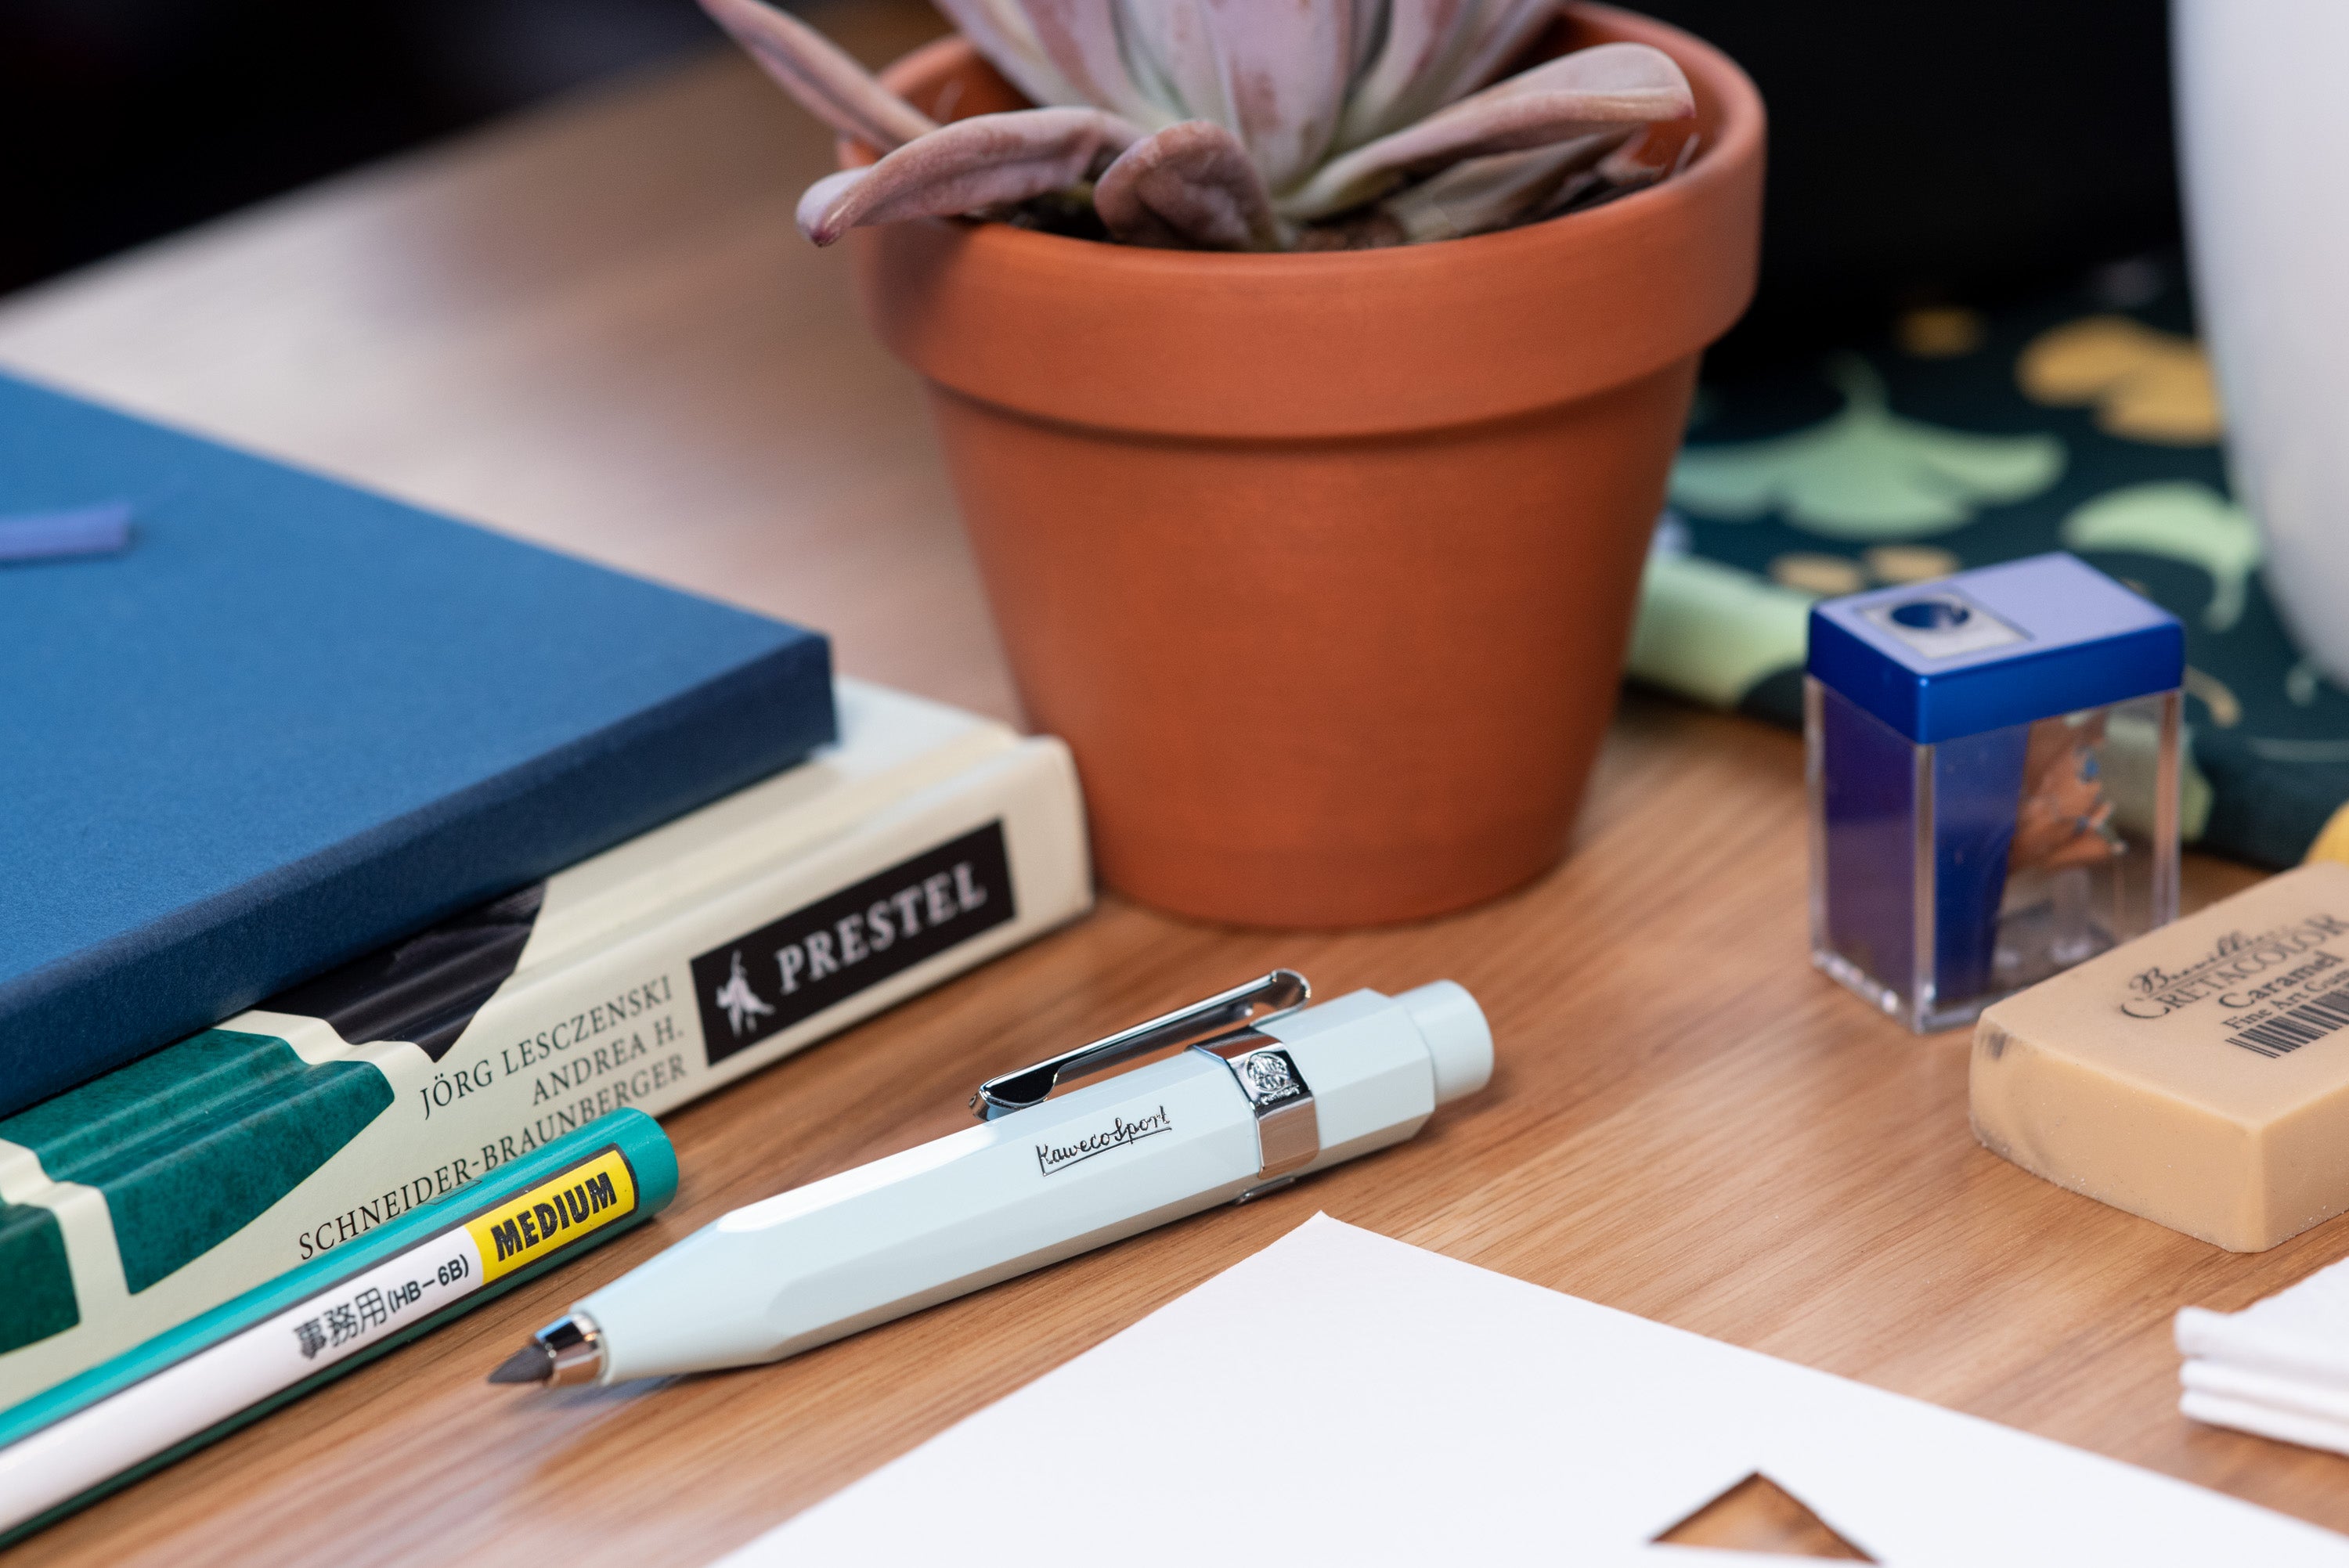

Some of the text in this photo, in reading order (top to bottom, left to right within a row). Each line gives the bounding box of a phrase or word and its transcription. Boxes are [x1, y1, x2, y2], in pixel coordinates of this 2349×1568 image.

[775, 862, 987, 995] PRESTEL
[2120, 914, 2349, 1018] CRETACOLOR
[2218, 950, 2344, 1008] Caramel
[2221, 1007, 2272, 1031] Fine
[2270, 991, 2310, 1011] Art
[420, 975, 672, 1119] JÖRG LESCZENSKI
[532, 1015, 685, 1106] ANDREA H.
[298, 1054, 687, 1260] SCHNEIDER-BRAUNBERGER
[491, 1171, 618, 1262] MEDIUM
